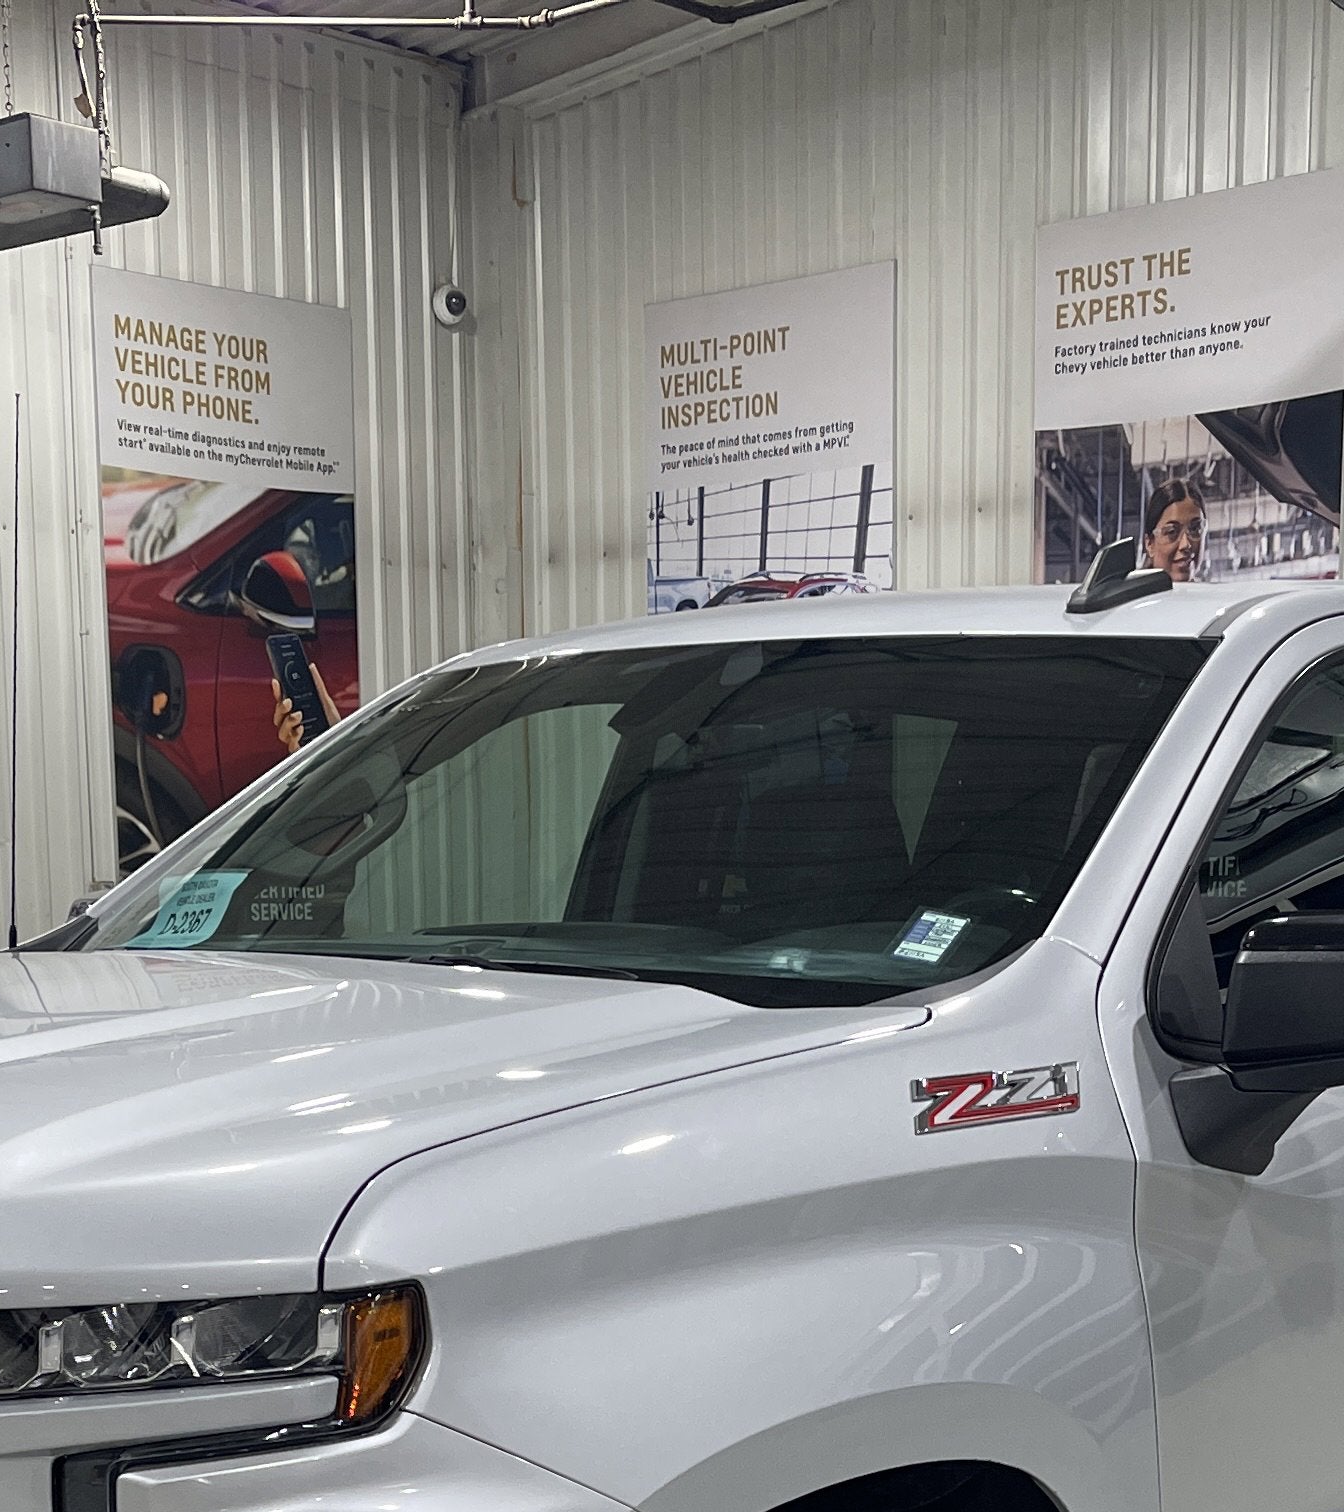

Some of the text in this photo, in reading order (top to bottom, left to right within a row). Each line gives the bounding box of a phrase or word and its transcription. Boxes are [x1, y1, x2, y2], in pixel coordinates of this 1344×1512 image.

[1055, 247, 1191, 296] TRUST THE
[1055, 287, 1176, 330] EXPERTS.
[114, 314, 269, 364] MANAGE YOUR
[660, 325, 790, 369] MULTI-POINT
[1054, 315, 1272, 358] Factory trained technicians know your
[114, 346, 272, 396] VEHICLE FROM
[1054, 338, 1244, 376] Chevy vehicle better than anyone.
[115, 378, 260, 425] YOUR PHONE.
[660, 365, 743, 399] VEHICLE
[661, 390, 779, 430] INSPECTION
[117, 418, 326, 457] View real-time diagnostics and enjoy remote
[148, 440, 191, 457] available
[193, 448, 205, 459] on
[207, 449, 224, 462] the
[225, 453, 284, 471] myChevrolet
[286, 458, 314, 472] Mobile
[661, 419, 854, 458] The peace of mind that comes from getting
[660, 459, 680, 474] your
[682, 453, 720, 469] vehicle's
[721, 449, 750, 464] health
[752, 444, 790, 460] checked
[791, 442, 813, 455] with
[814, 442, 821, 452] a
[157, 907, 213, 936] D-2367
[250, 902, 314, 921] SERVICE
[909, 1060, 1081, 1136] Z71
